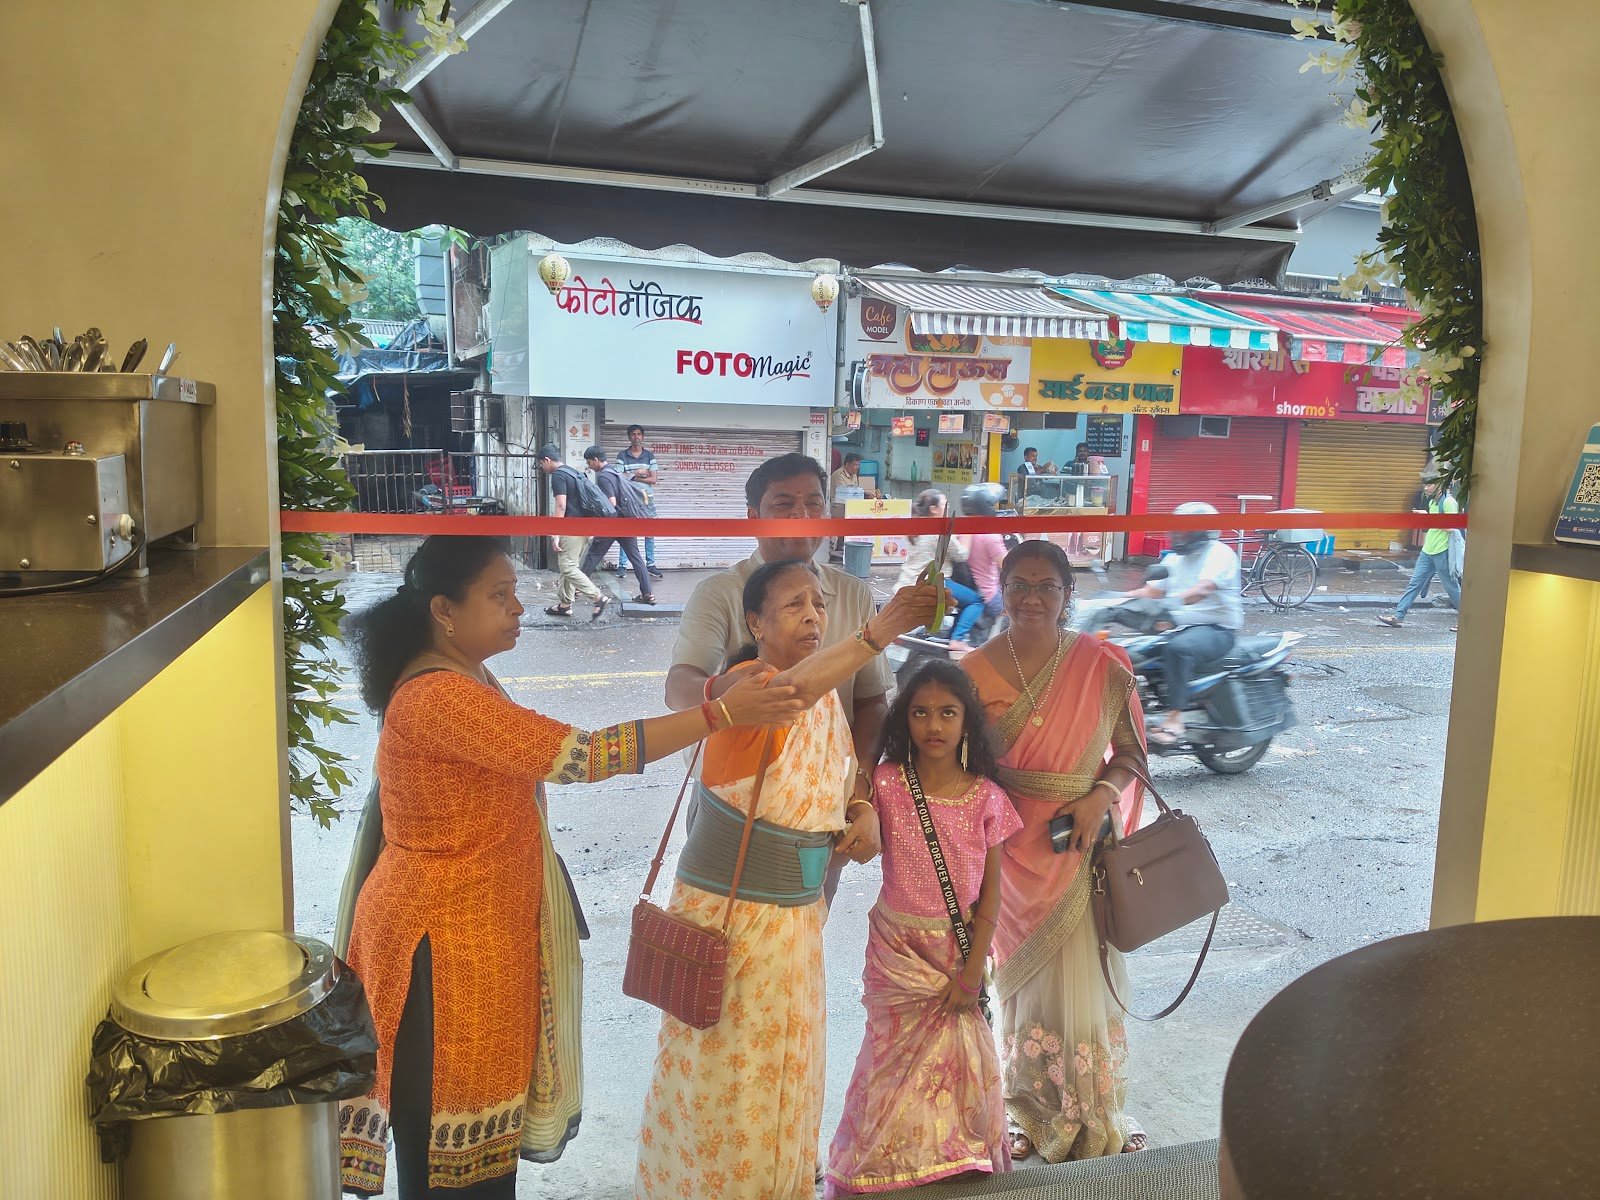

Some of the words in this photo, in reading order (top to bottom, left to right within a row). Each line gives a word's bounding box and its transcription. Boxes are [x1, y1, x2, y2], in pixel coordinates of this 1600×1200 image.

[866, 305, 893, 326] Cafe
[866, 326, 889, 334] MODEL
[1038, 373, 1085, 400] साई
[650, 443, 672, 453] SHOP
[674, 461, 701, 472] SUNDAY
[703, 462, 736, 473] CLOSED
[917, 801, 932, 834] YOUNG
[928, 841, 949, 883] FOREVER
[943, 884, 958, 915] YOUNG
